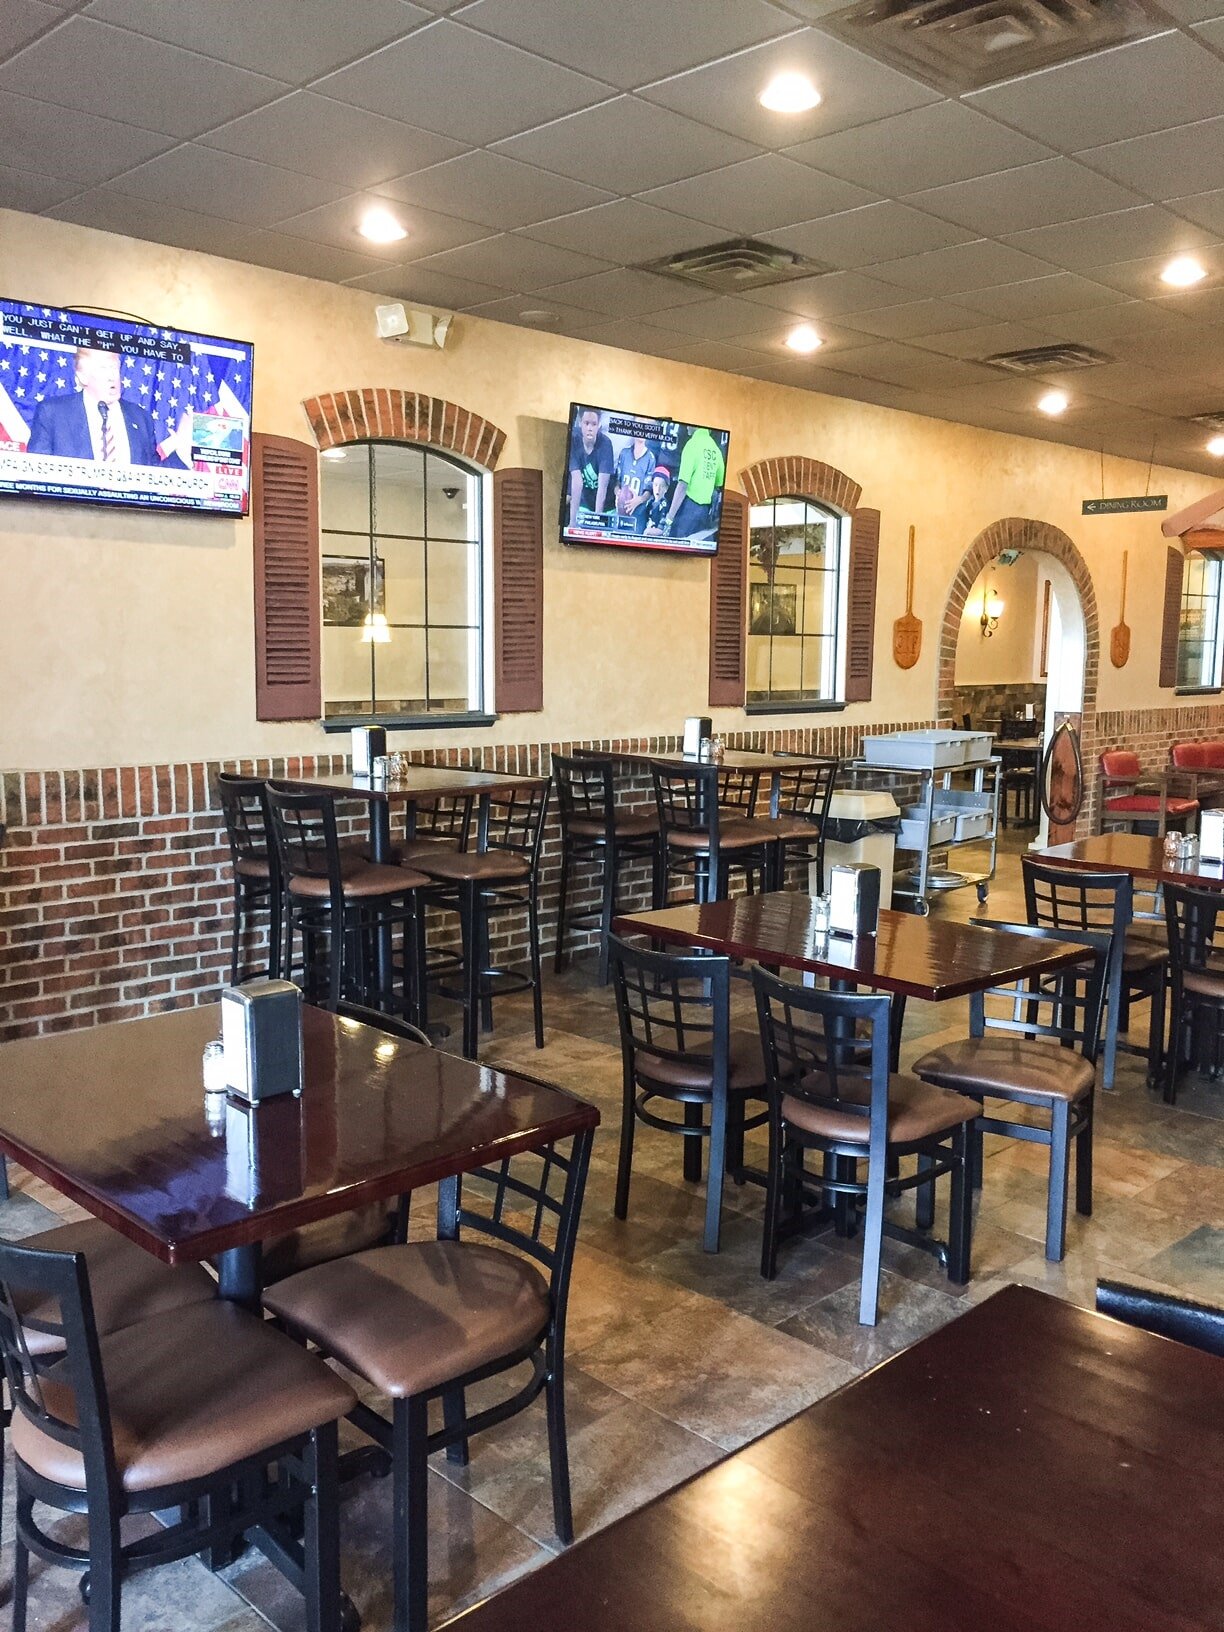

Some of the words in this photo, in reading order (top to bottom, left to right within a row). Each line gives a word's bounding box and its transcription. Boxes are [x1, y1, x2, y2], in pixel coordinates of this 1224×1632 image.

[3, 314, 23, 324] YOU
[28, 319, 54, 329] JUST
[59, 323, 90, 335] CAN'T
[96, 329, 114, 339] GET
[120, 333, 133, 342] UP
[138, 336, 156, 346] AND
[40, 331, 66, 342] WHAT
[73, 336, 91, 347] THE
[120, 344, 139, 354] YOU
[143, 348, 167, 360] HAVE
[171, 352, 184, 362] TO
[218, 467, 240, 475] LIVE
[1100, 501, 1129, 510] DINING
[1130, 498, 1162, 509] ROOM
